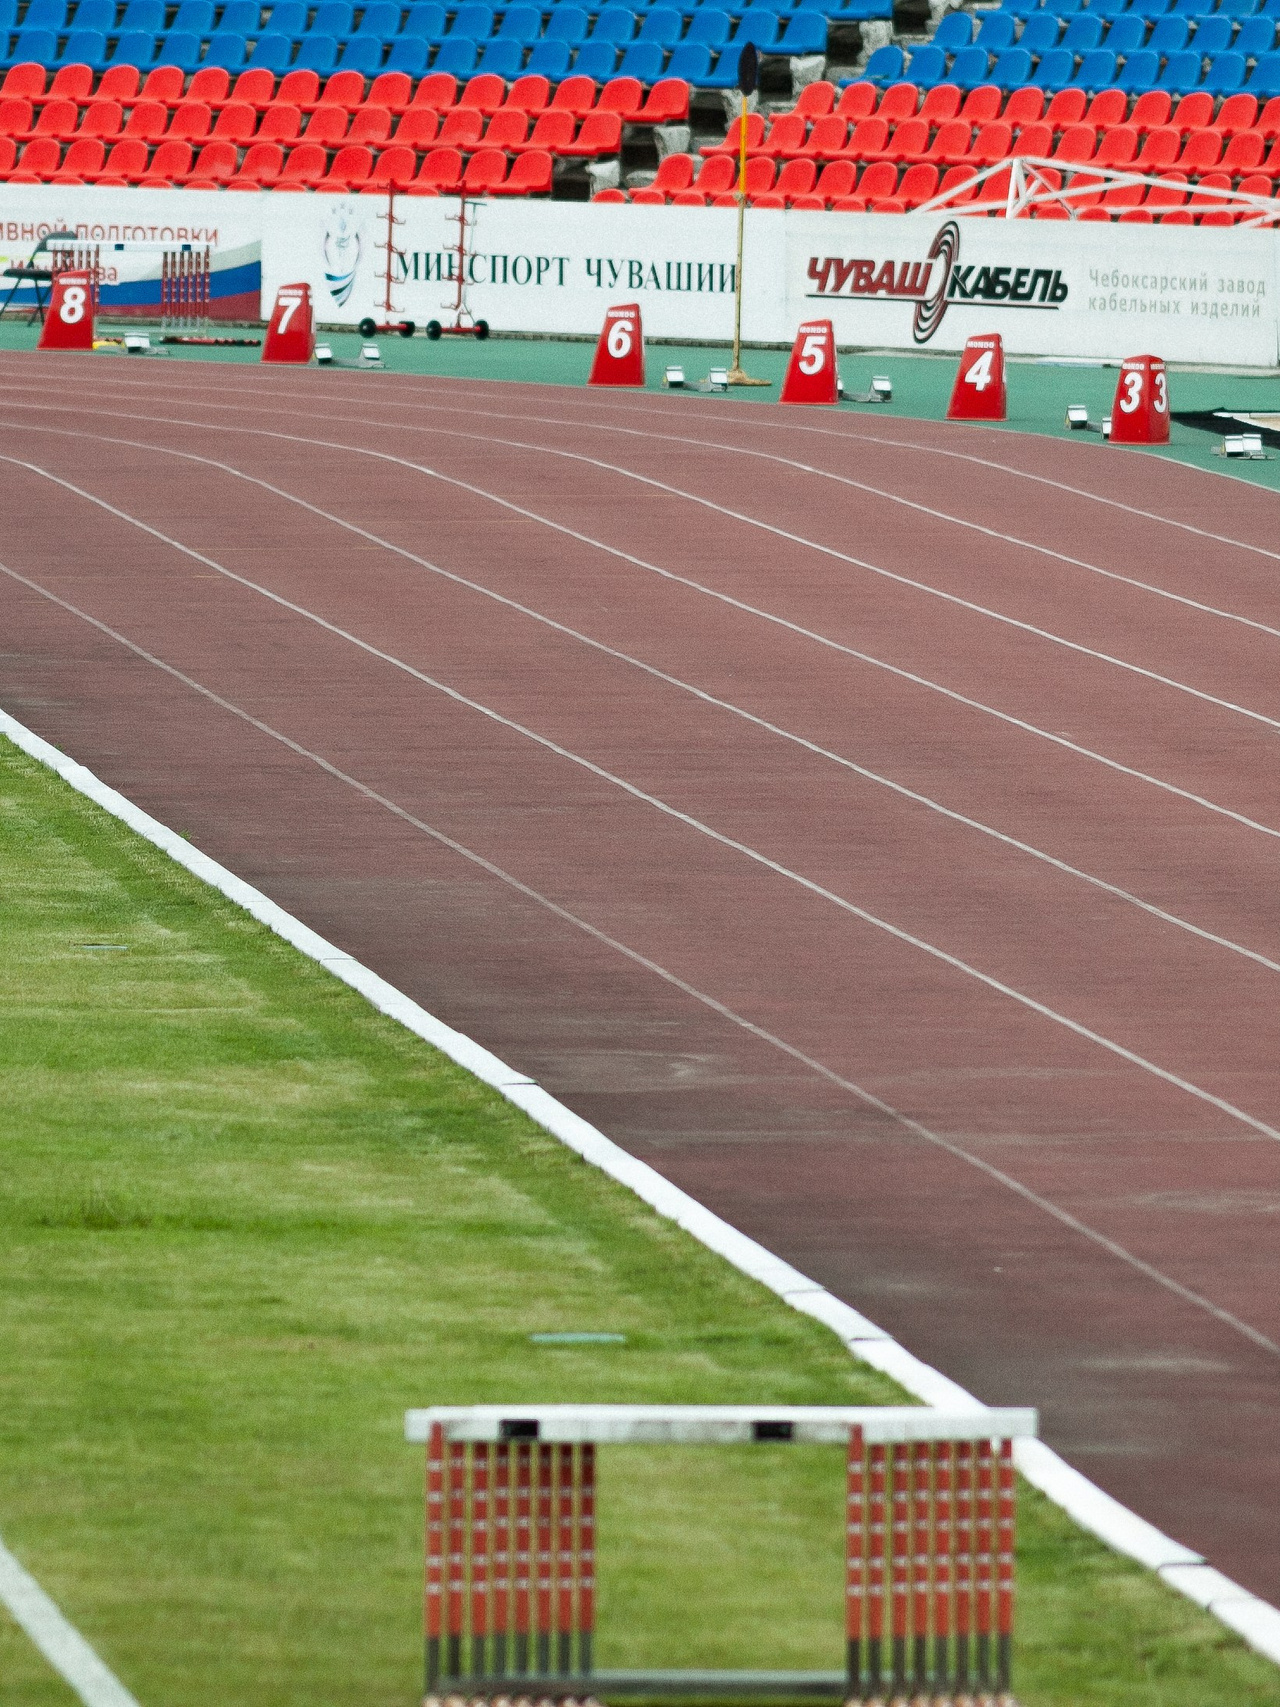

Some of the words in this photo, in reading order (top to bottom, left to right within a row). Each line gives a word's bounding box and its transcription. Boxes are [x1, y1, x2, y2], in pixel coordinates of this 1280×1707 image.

[396, 251, 570, 287] МИНСПОРТ
[585, 257, 737, 293] ЧУВАШИИ
[1089, 268, 1208, 293] Чебоксарский
[1218, 278, 1266, 297] завод
[60, 286, 86, 324] 8
[277, 297, 302, 335] 7
[1088, 292, 1181, 314] кабельных
[1190, 299, 1261, 319] изделий
[607, 320, 634, 359] 6
[798, 335, 826, 375] 5
[964, 350, 993, 391] 4
[1119, 372, 1143, 413] 3
[1153, 372, 1167, 413] 3
